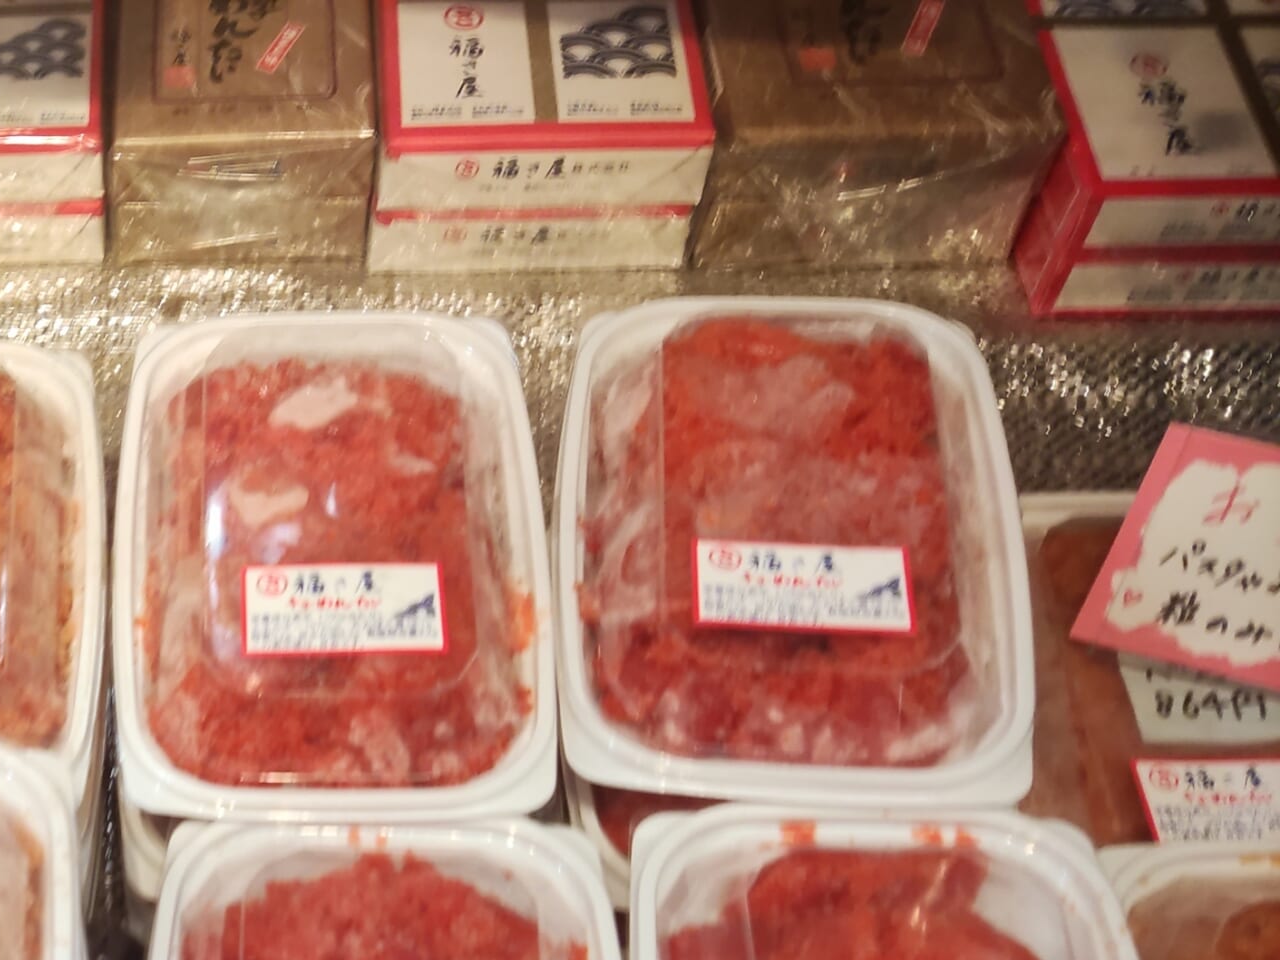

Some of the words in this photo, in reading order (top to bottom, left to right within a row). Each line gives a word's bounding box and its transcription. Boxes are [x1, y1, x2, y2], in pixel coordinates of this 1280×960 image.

[441, 36, 485, 98] 福さ屋
[491, 155, 567, 181] 福さ屋
[749, 551, 836, 572] 福さ屋
[296, 569, 375, 594] 福さ屋
